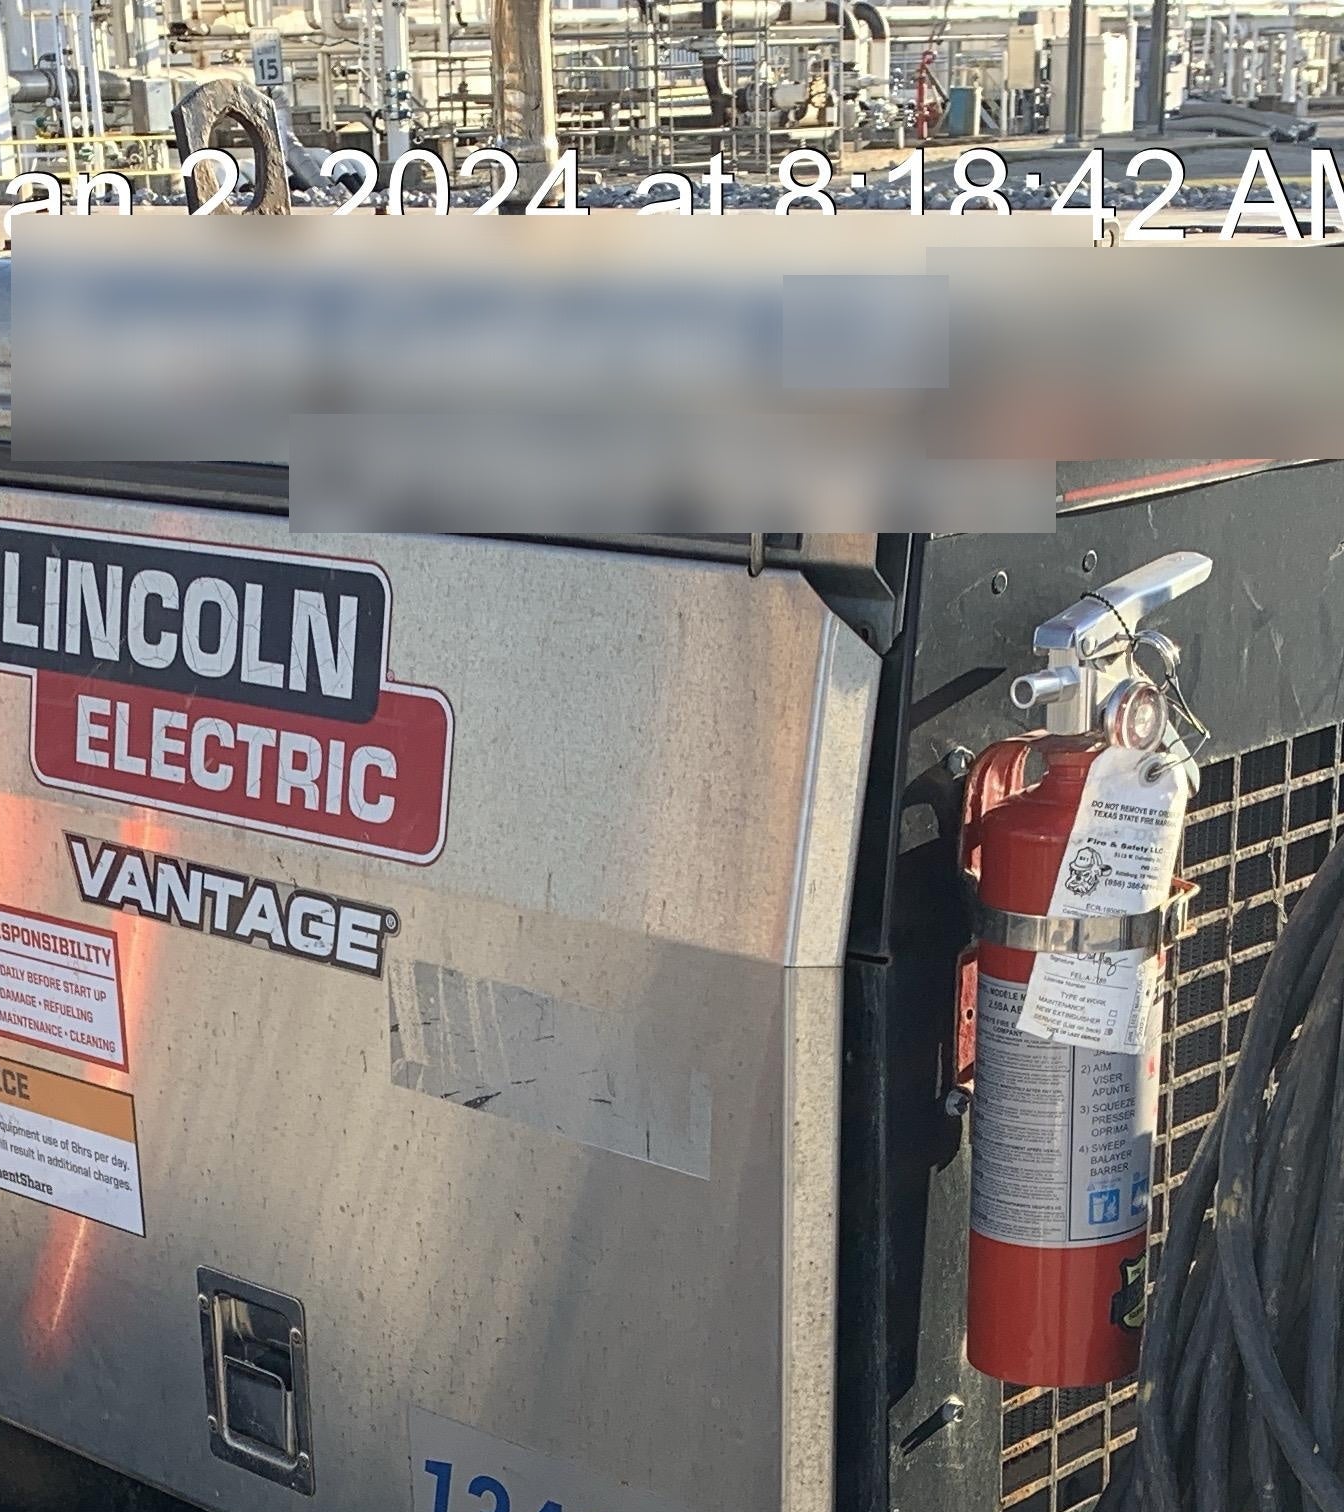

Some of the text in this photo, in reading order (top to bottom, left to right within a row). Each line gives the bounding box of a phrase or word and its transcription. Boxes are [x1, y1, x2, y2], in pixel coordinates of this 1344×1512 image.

[259, 59, 279, 80] 15
[2, 551, 359, 701] LINCOLN
[75, 694, 398, 824] ELECTRIC
[1092, 800, 1103, 808] DO
[1120, 805, 1147, 815] REMOVE
[1093, 810, 1116, 820] TEXAS
[1119, 813, 1138, 823] STATE
[1087, 837, 1107, 847] Fire
[1121, 842, 1149, 854] Safety
[66, 835, 384, 971] VANTAGE
[0, 964, 25, 982] DAILY
[27, 971, 61, 991] BEFORE
[63, 981, 91, 998] START
[93, 989, 107, 1003] UP
[0, 988, 37, 1008] DAMAGE
[43, 999, 94, 1024] REFUELING
[1061, 991, 1078, 1001] TYPE
[1086, 998, 1106, 1006] WORK
[69, 1030, 116, 1053] CLEANING
[1081, 1062, 1112, 1075] 2) AIM
[1093, 1072, 1123, 1085] VISER
[1092, 1083, 1131, 1097] APUNTE
[1080, 1097, 1136, 1116] 3) SQUEEZE
[1091, 1109, 1136, 1124] PRESSER
[1091, 1123, 1128, 1137] OPRIMA
[42, 1135, 59, 1147] use
[60, 1139, 69, 1150] of
[94, 1151, 109, 1163] per
[111, 1154, 130, 1172] day.
[1091, 1139, 1126, 1153] SWEEP
[1090, 1149, 1133, 1165] BALAYER
[9, 1143, 35, 1160] result
[37, 1150, 46, 1163] in
[47, 1155, 91, 1178] additional
[93, 1170, 132, 1191] charges.
[1090, 1162, 1129, 1177] BARRER
